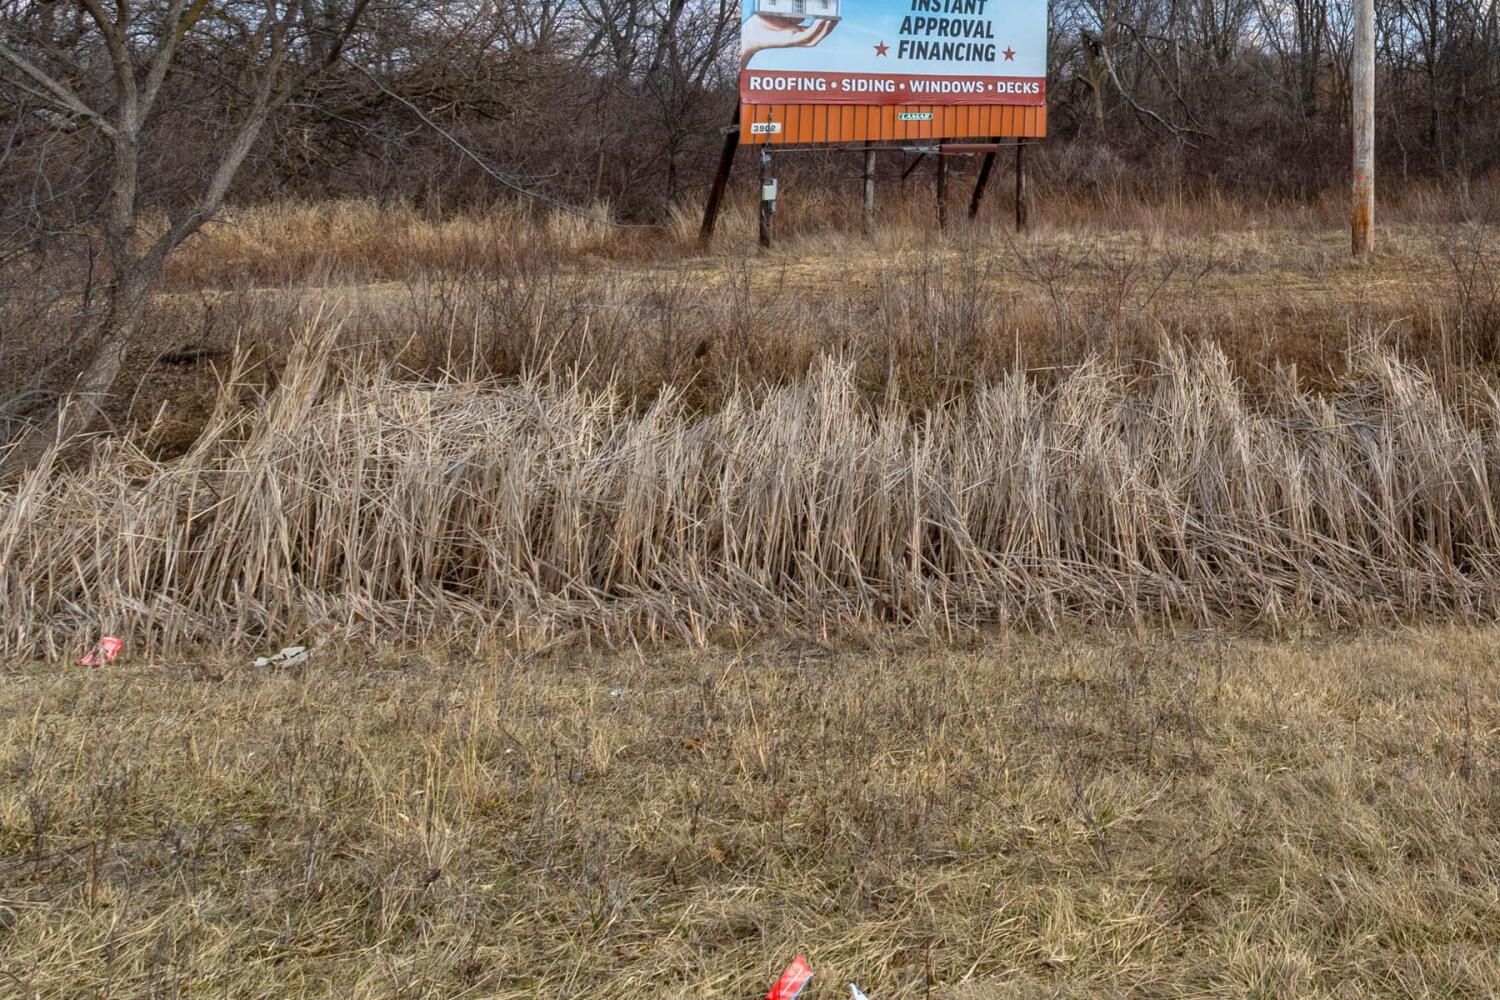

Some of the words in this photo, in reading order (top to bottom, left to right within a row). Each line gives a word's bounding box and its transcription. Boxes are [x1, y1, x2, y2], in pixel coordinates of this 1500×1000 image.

[898, 15, 995, 39] APPROVAL
[897, 39, 996, 62] FINANCING
[749, 76, 826, 92] ROOFING
[841, 77, 895, 93] SIDING
[909, 79, 984, 94] WINDOWS
[996, 81, 1040, 95] DECKS
